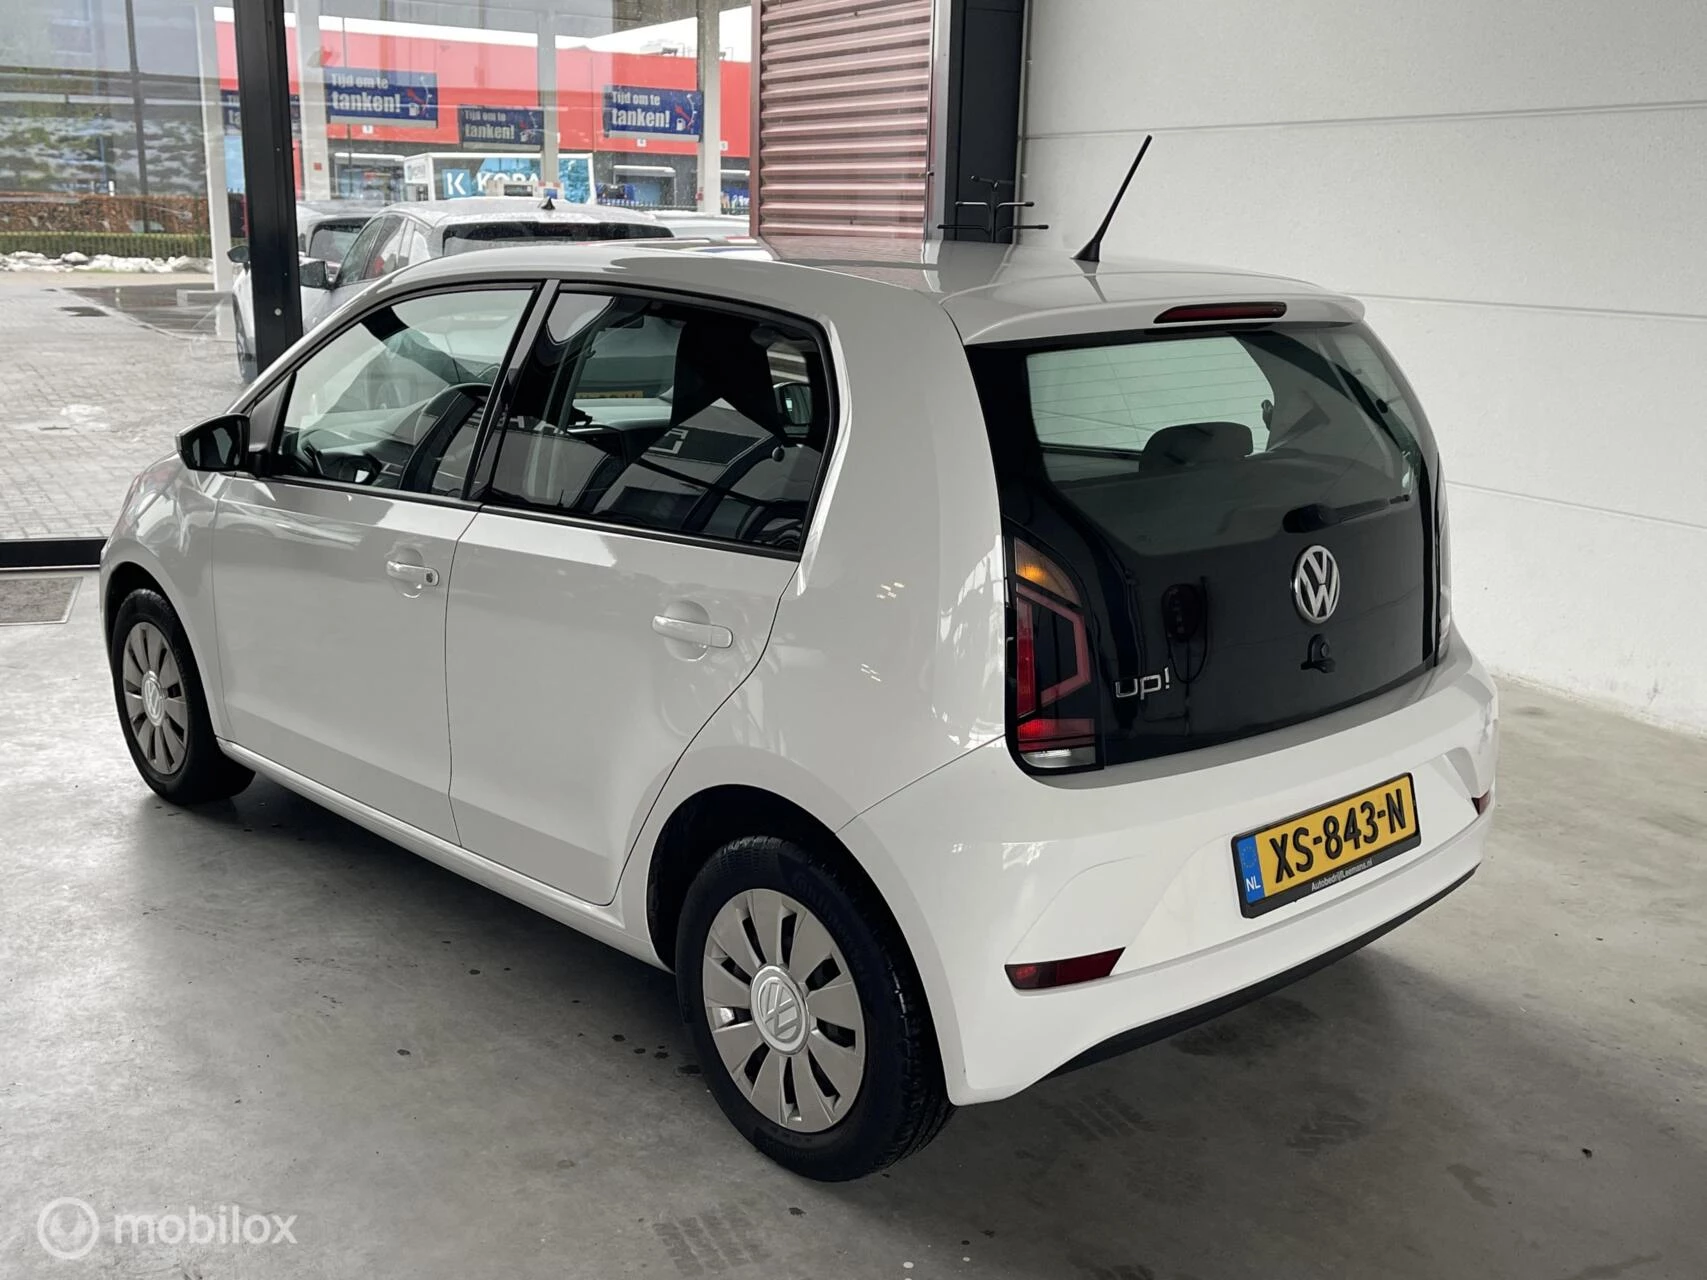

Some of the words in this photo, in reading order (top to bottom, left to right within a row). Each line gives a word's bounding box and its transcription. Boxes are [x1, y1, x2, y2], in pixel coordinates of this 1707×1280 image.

[331, 73, 353, 88] Tijd
[355, 76, 375, 88] om
[376, 76, 389, 89] te
[331, 91, 401, 113] tanken!
[611, 91, 631, 105] Tijd
[632, 94, 649, 105] om
[649, 94, 661, 105] te
[464, 109, 480, 121] Tijd
[482, 111, 496, 121] om
[611, 108, 671, 128] tanken!
[464, 123, 515, 140] tanken!
[1115, 667, 1170, 700] up!
[1269, 788, 1407, 884] XS-843-N
[1245, 876, 1262, 893] NL
